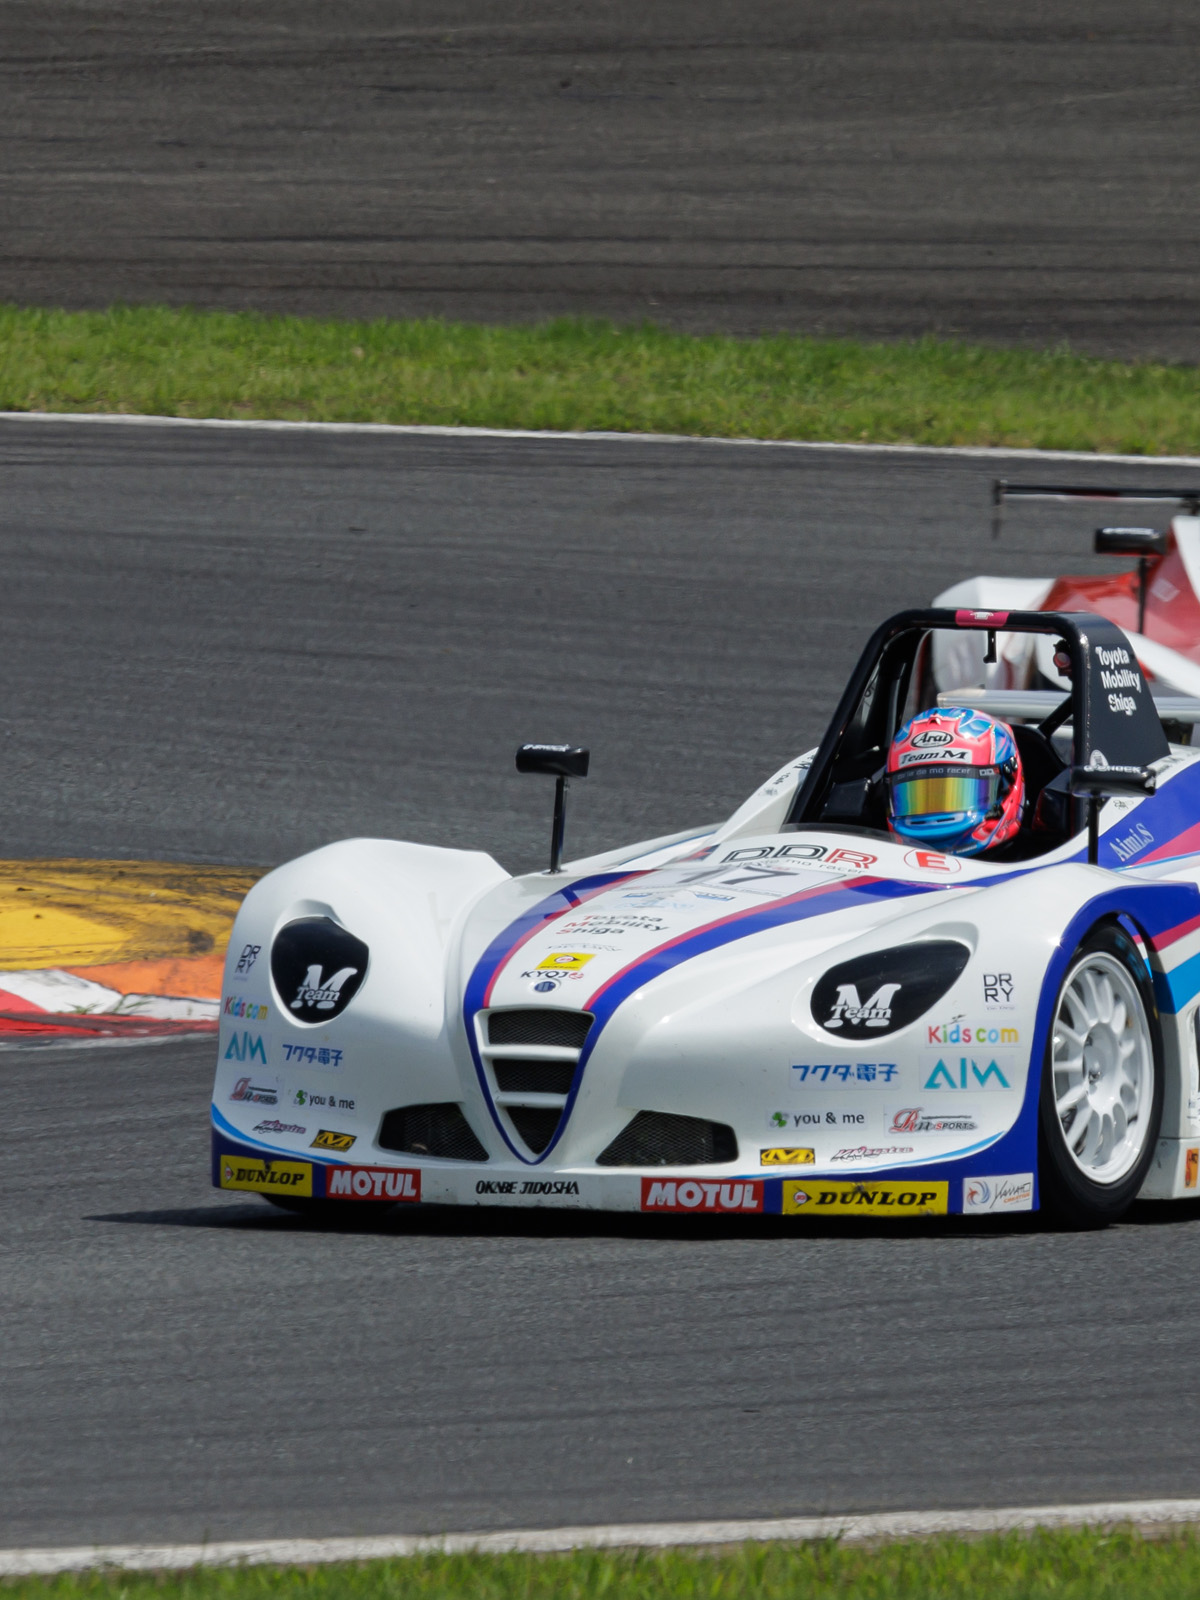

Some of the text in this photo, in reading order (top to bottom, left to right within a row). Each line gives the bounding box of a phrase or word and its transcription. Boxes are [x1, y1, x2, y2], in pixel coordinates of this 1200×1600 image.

[1095, 646, 1130, 670] Toyota
[1101, 669, 1140, 693] Mobility
[1108, 694, 1136, 716] Shiga
[900, 749, 969, 766] Team M
[946, 767, 971, 775] racer
[818, 864, 868, 875] racer
[564, 921, 670, 932] Mobility
[583, 914, 663, 924] Toyota
[555, 927, 626, 936] Shiga
[982, 973, 1014, 988] DR
[295, 986, 341, 1003] Team
[984, 987, 1015, 1003] RY
[223, 997, 246, 1014] Kids
[830, 1003, 893, 1021] Team
[927, 1023, 1019, 1044] Kids com
[224, 1031, 267, 1065] AIM
[791, 1062, 899, 1082] フクダ電子
[923, 1057, 1011, 1089] AIM
[309, 1094, 356, 1111] you & me
[793, 1110, 865, 1127] you & me
[934, 1121, 978, 1132] SPORTS
[235, 1166, 305, 1187] DUNLOP
[329, 1170, 418, 1198] MOTUL
[475, 1180, 581, 1196] OKABE JIDOSHA
[646, 1180, 759, 1209] MOTUL
[815, 1190, 938, 1207] DUNLOP
